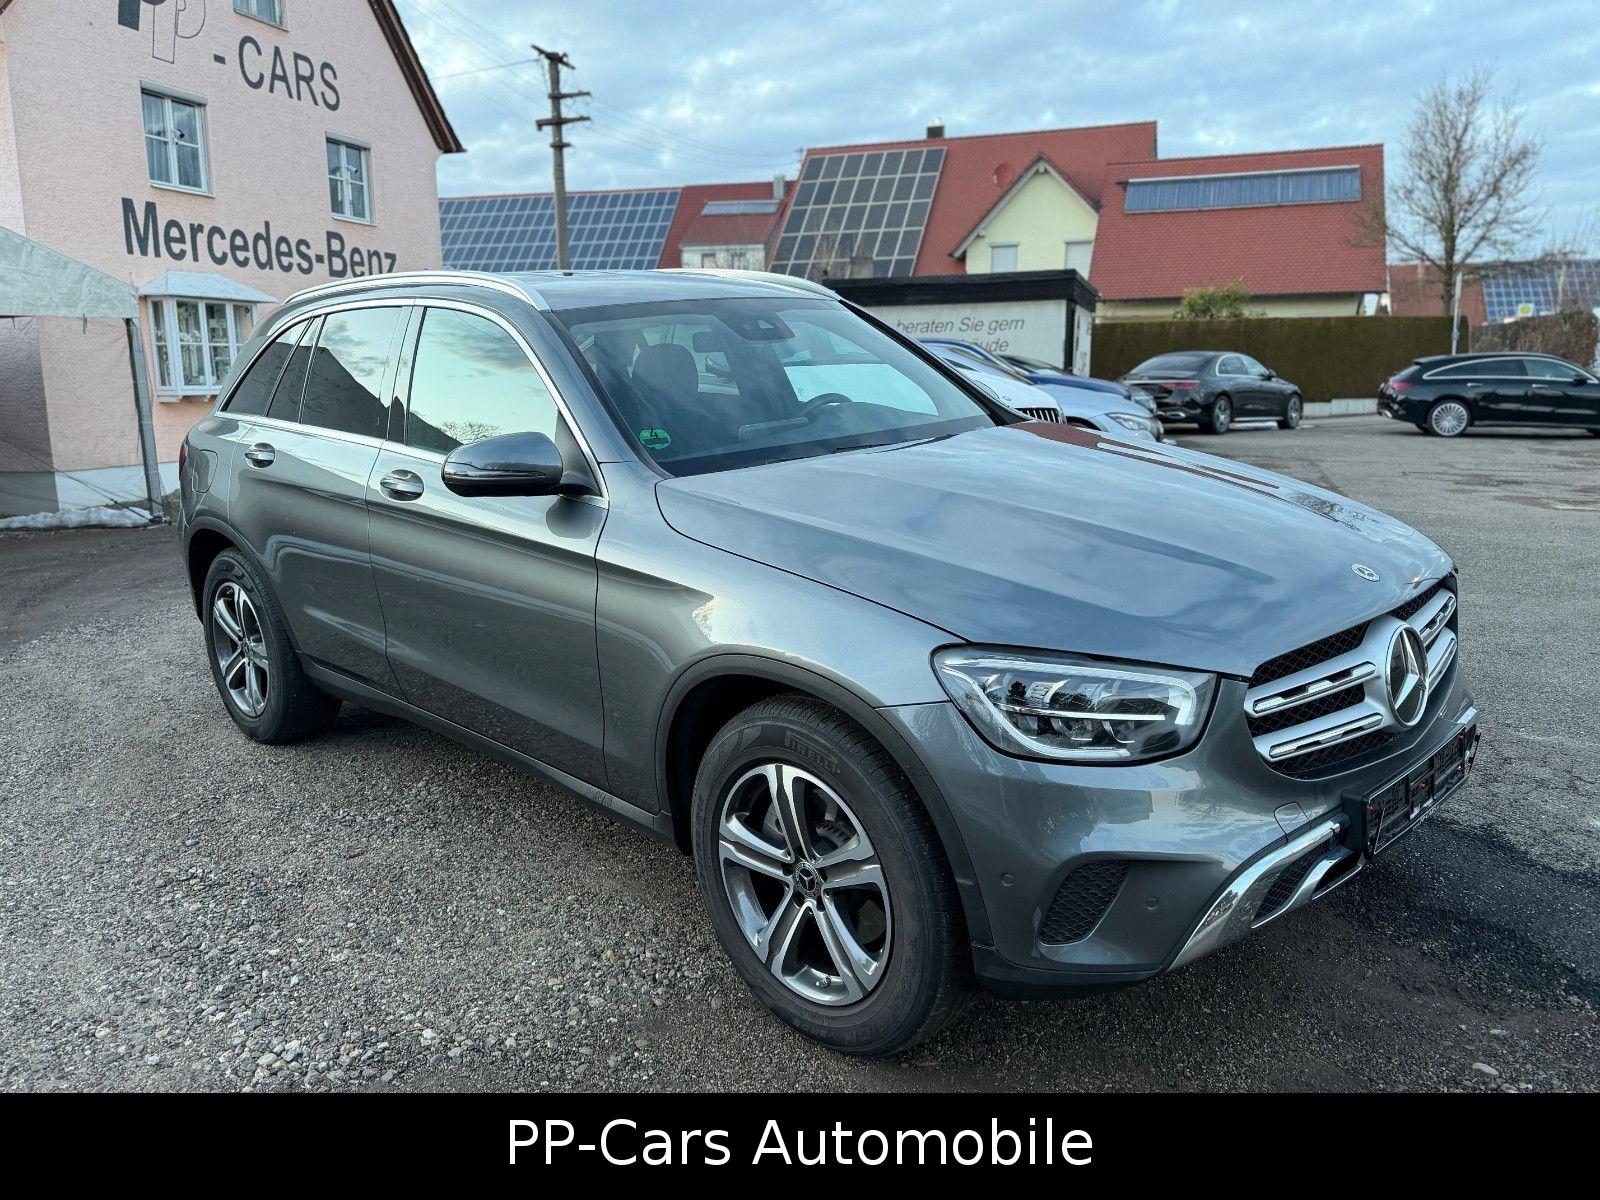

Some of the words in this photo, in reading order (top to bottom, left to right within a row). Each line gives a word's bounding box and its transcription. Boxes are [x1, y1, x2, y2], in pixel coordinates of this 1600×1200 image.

[121, 197, 397, 278] Mercedes-Benz
[958, 317, 984, 333] Sie
[987, 318, 1025, 335] gern
